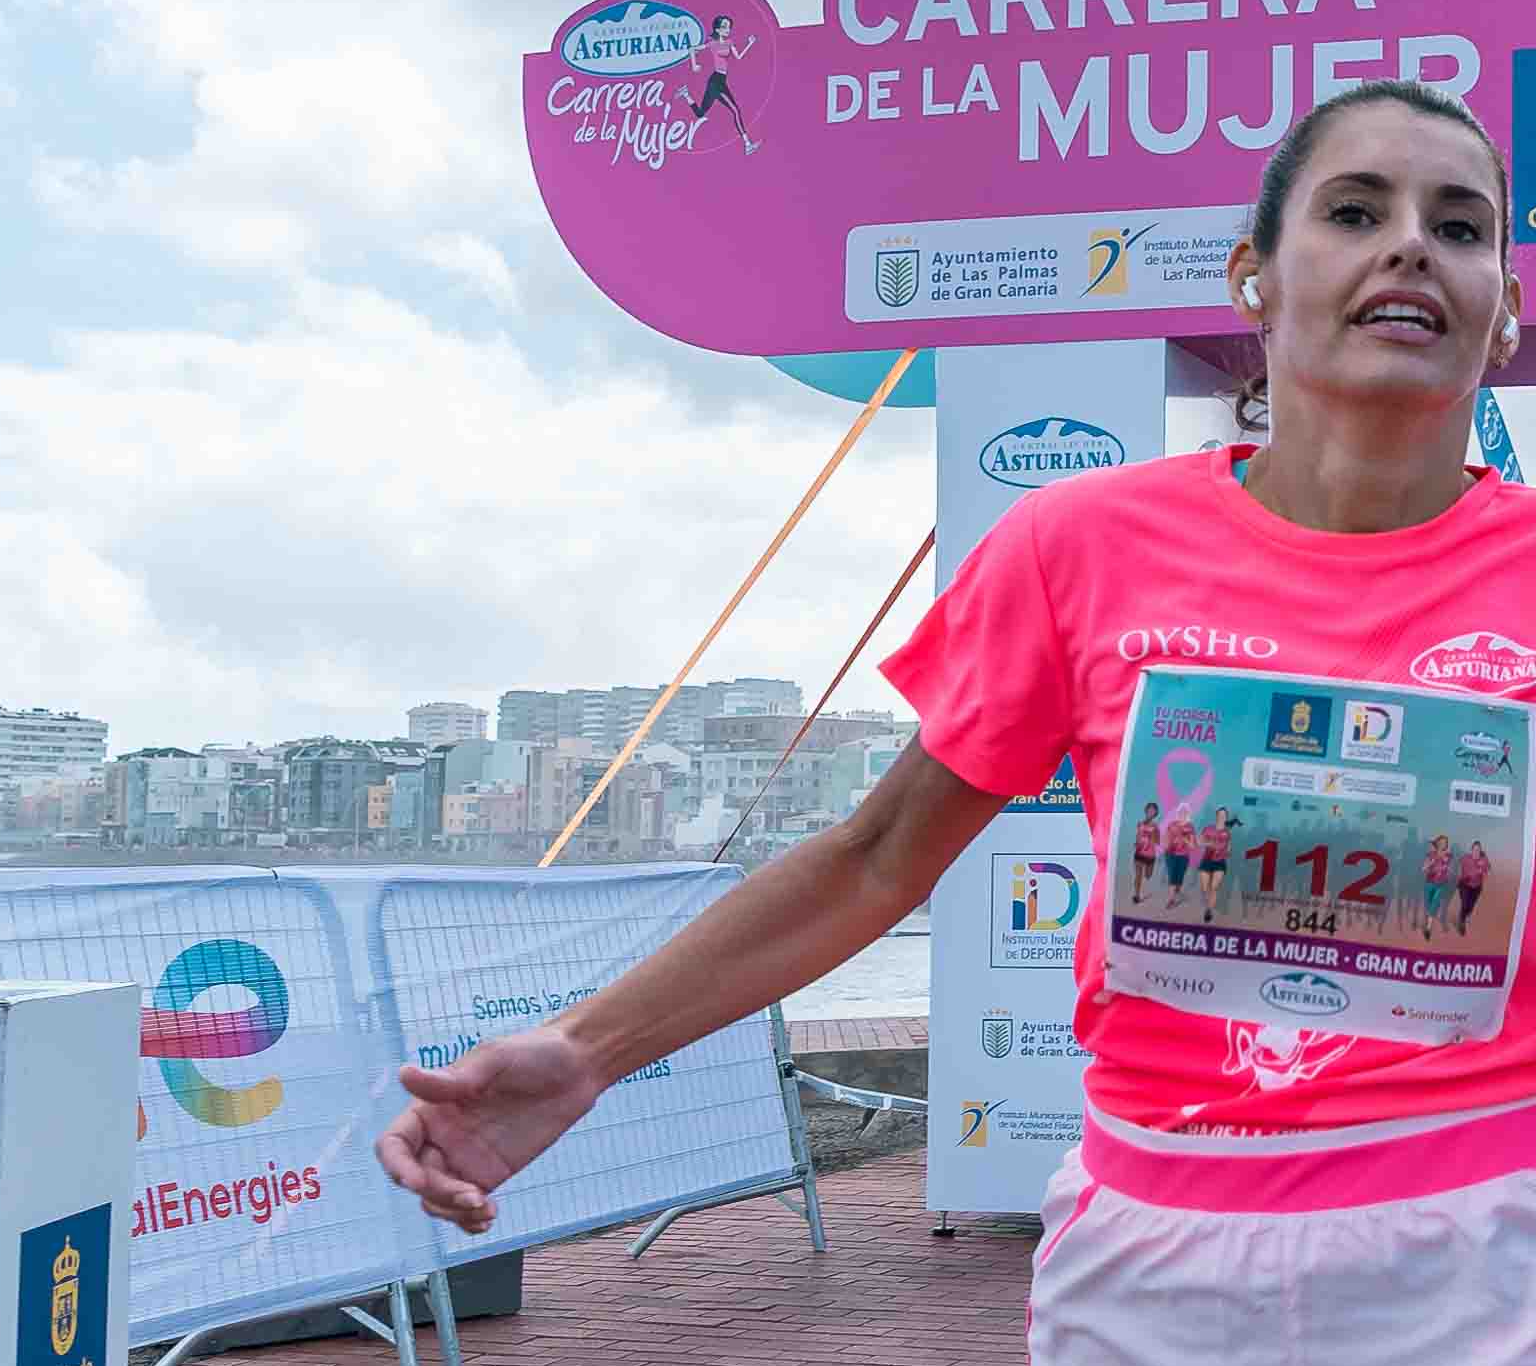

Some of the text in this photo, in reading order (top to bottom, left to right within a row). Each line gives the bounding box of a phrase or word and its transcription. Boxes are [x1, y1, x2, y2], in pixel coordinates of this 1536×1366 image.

[573, 32, 691, 60] ASTURIANA
[547, 75, 665, 116] Carrera
[825, 69, 901, 123] DE
[922, 63, 1001, 116] LA
[574, 105, 708, 170] de la Mujer
[932, 248, 1058, 270] Ayuntamiento
[931, 264, 1058, 284] de Las Palmas
[1164, 269, 1183, 281] Las
[931, 281, 1058, 301] de Gran Canaria
[991, 446, 1113, 471] ASTURIANA
[1118, 626, 1278, 662] OYSHO
[1155, 707, 1222, 724] TU DORSAL
[1152, 719, 1217, 744] SUMA
[1245, 839, 1390, 905] 112
[1284, 908, 1338, 935] 844
[1006, 950, 1017, 960] DE
[1120, 924, 1494, 984] CARRERA DE LA MUJER GRAN CANARIA
[1145, 969, 1215, 996] OYSHO
[1266, 980, 1342, 1010] ASTURIANA
[473, 995, 541, 1019] Somos
[1407, 1007, 1469, 1024] Santander
[1021, 1035, 1035, 1043] de
[1042, 1035, 1060, 1043] Las
[1021, 1046, 1063, 1056] de Gran
